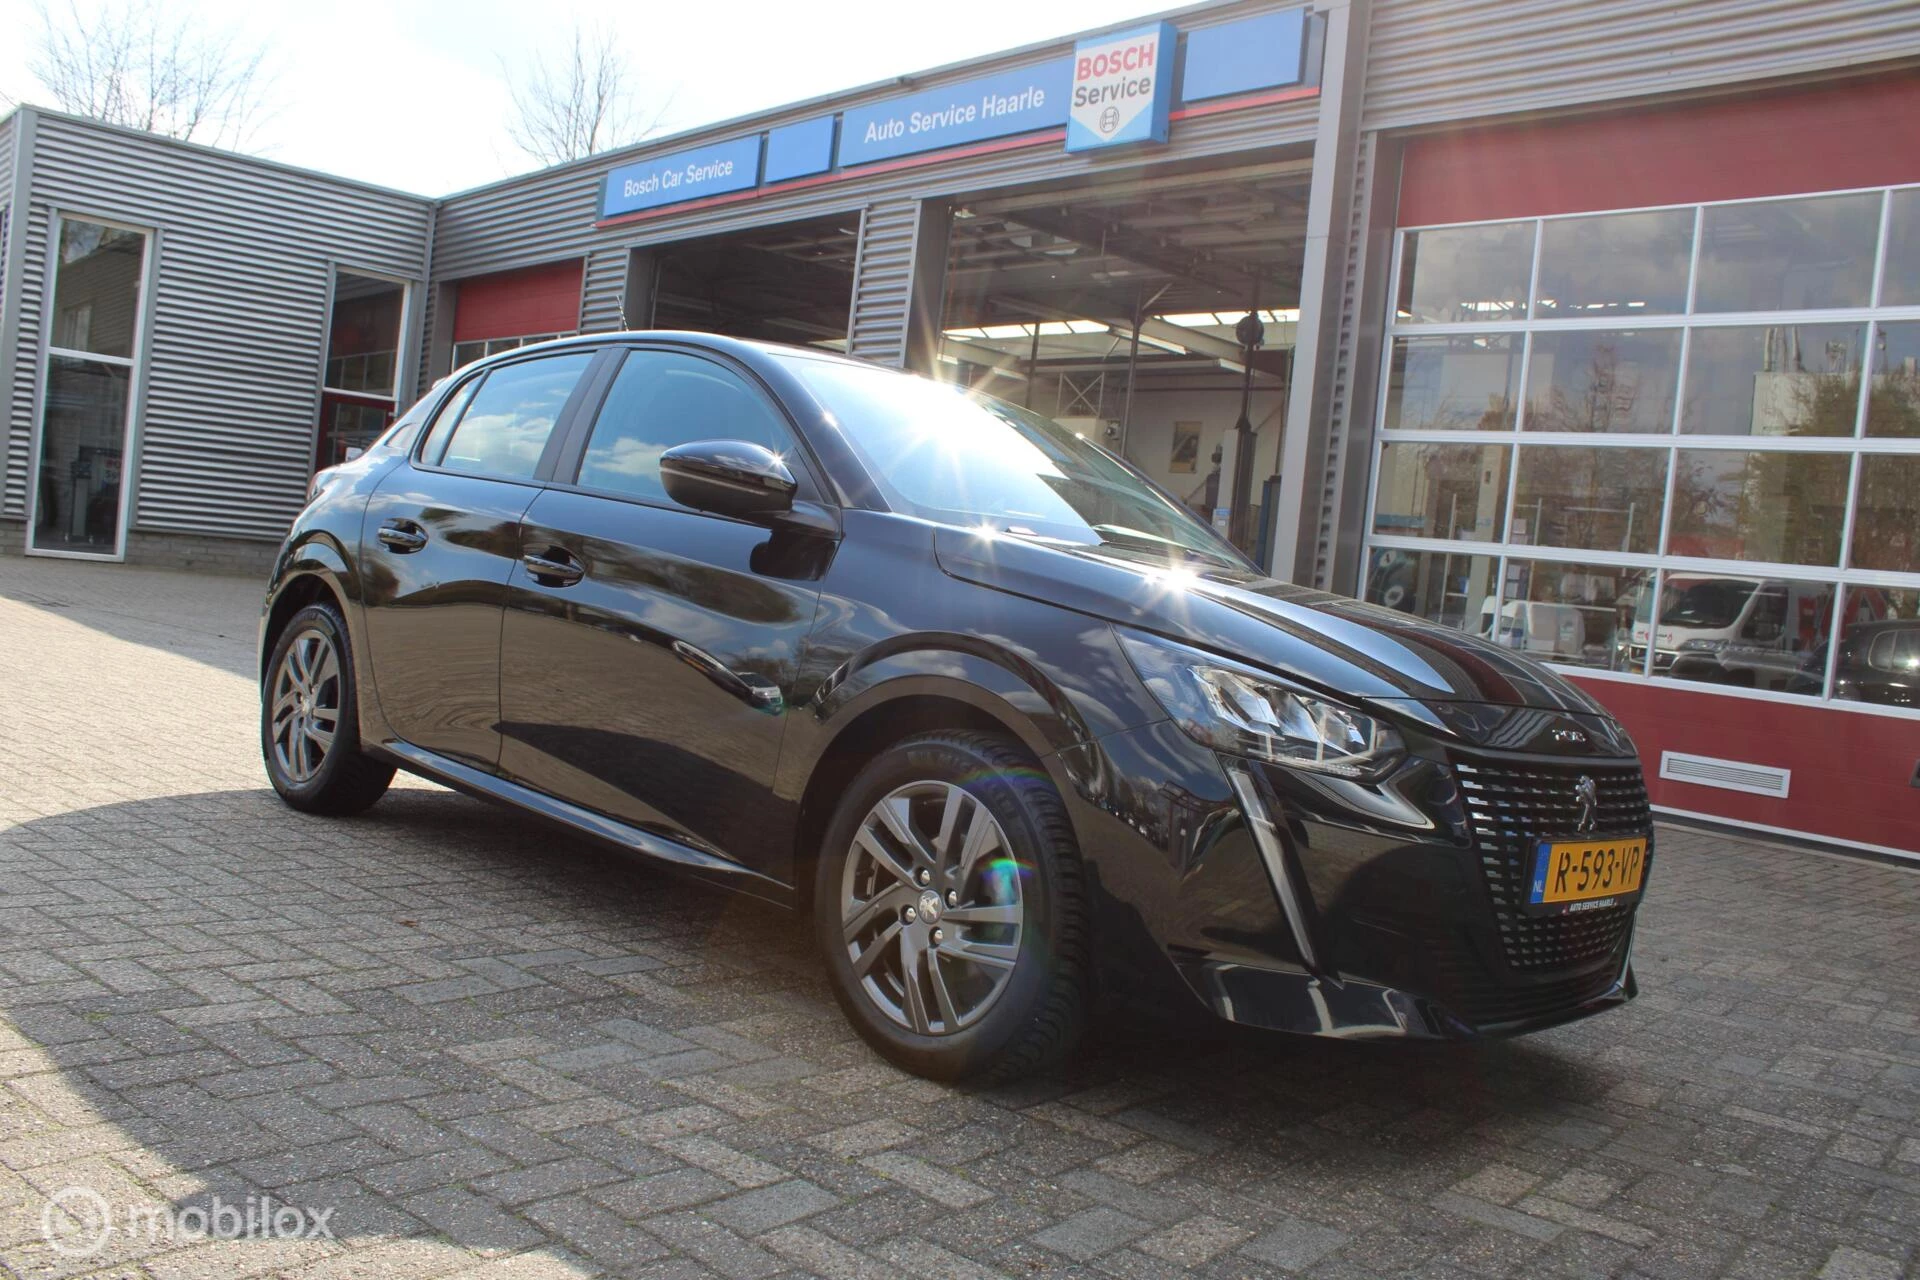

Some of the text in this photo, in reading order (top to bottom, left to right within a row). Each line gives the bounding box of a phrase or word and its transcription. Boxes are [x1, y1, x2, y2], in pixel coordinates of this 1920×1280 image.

[1077, 41, 1155, 81] BOSCH
[1073, 76, 1152, 108] Service
[864, 86, 1045, 144] Auto Service Haarle
[624, 160, 733, 198] Bosch Car Service
[1532, 880, 1544, 893] NL
[1554, 846, 1641, 893] R-593-VP
